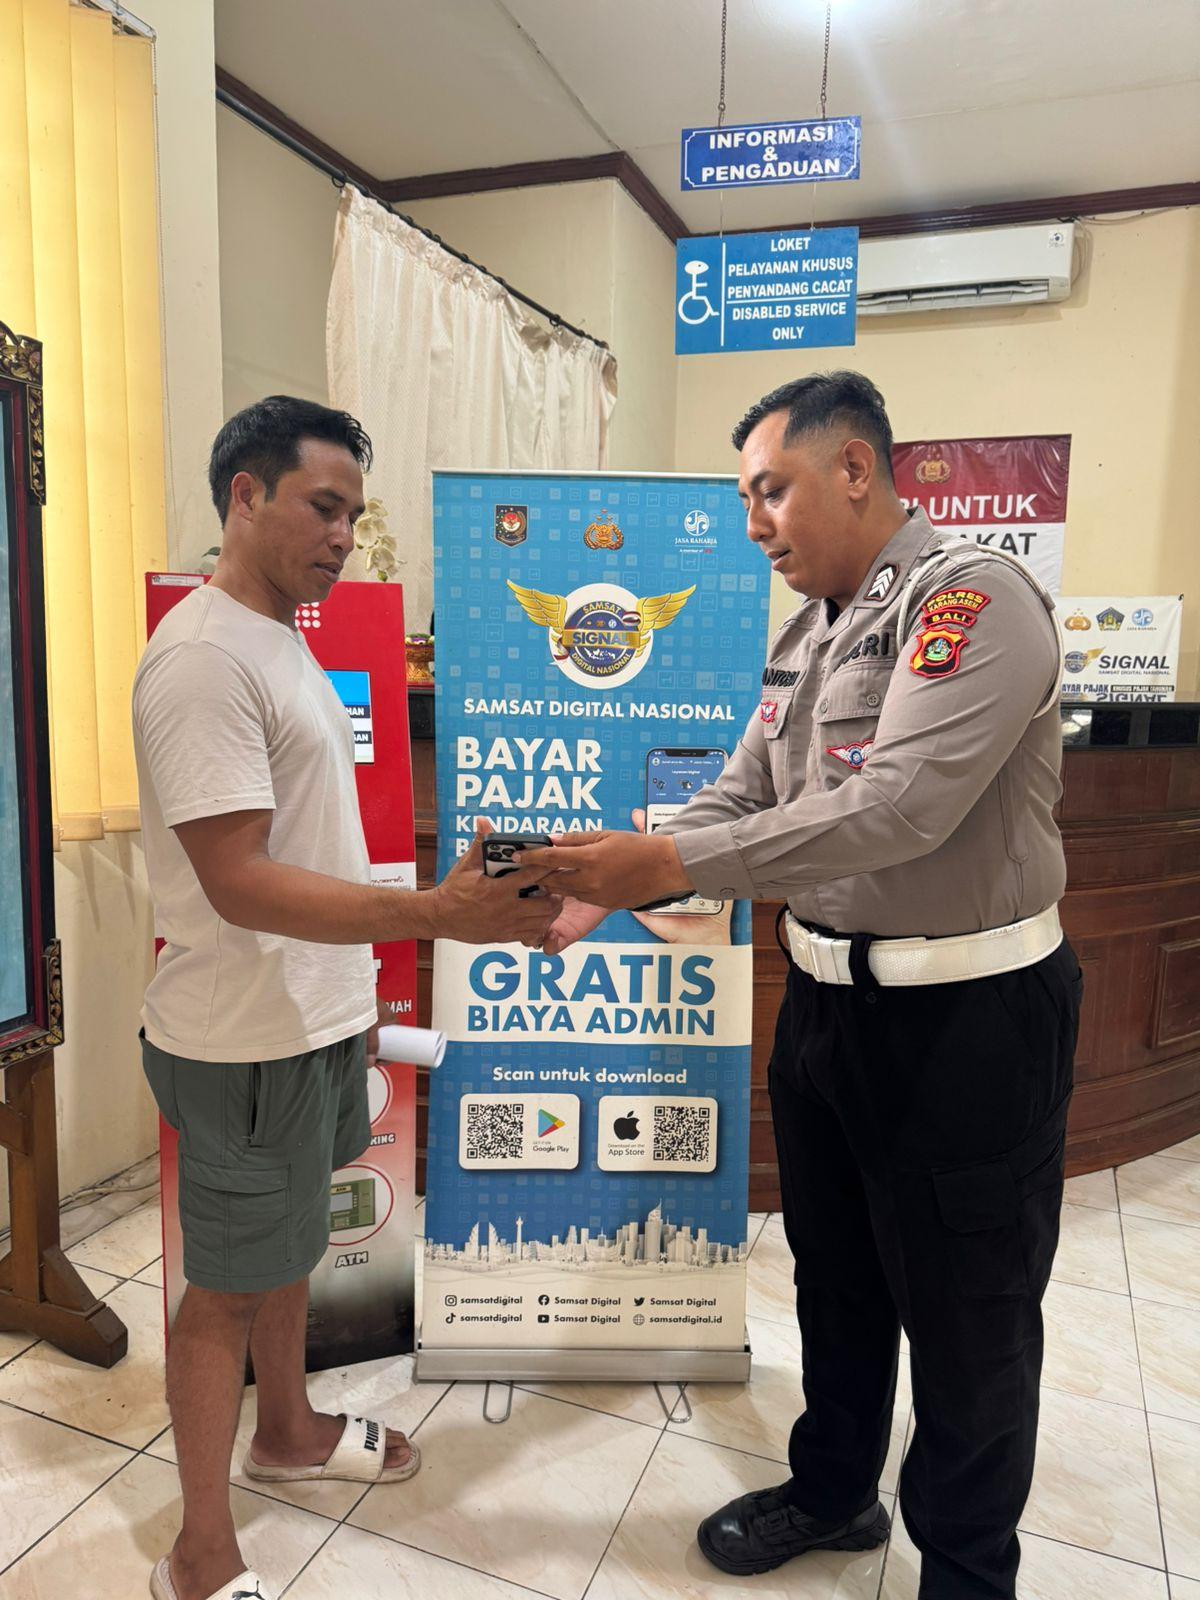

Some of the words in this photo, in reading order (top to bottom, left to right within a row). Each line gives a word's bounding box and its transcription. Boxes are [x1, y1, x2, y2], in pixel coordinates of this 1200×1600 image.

[709, 126, 833, 149] INFORMASI
[763, 146, 778, 161] &
[701, 159, 840, 182] PENGADUAN
[771, 237, 811, 252] LOKET
[728, 261, 799, 277] PELAYANAN
[802, 257, 853, 272] KHUSUS
[727, 281, 809, 299] PENYANDANG
[812, 279, 853, 294] CACAT
[732, 304, 791, 320] DISABLED
[794, 302, 847, 316] SERVICE
[772, 326, 804, 340] ONLY
[929, 493, 1038, 520] UNTUK
[927, 591, 984, 607] POLRES
[582, 602, 622, 615] SAMSAT
[932, 613, 967, 622] BALI
[572, 631, 630, 646] SIGNAL
[571, 652, 596, 673] DIGITAL
[596, 652, 632, 674] NASIONAL
[1098, 655, 1170, 669] SIGNAL
[1061, 683, 1082, 693] AYAR
[1083, 684, 1109, 693] PAJAK
[464, 698, 544, 715] SAMSAT
[549, 701, 624, 718] DIGITAL
[630, 703, 735, 721] NASIONAL
[457, 736, 603, 773] BAYAR
[456, 774, 602, 811] PAJAK
[469, 950, 716, 1006] GRATIS
[467, 1005, 576, 1032] BIAYA
[585, 1007, 715, 1036] ADMIN
[493, 1067, 534, 1082] Scan
[540, 1067, 590, 1082] untuk
[595, 1068, 687, 1084] download
[370, 1133, 396, 1146] KING
[533, 1145, 555, 1153] Google
[557, 1145, 569, 1153] Play
[336, 1251, 369, 1268] ATM
[460, 1295, 523, 1307] samsatdigital
[554, 1296, 588, 1306] Samsat
[591, 1296, 621, 1308] Digital
[650, 1297, 684, 1307] Samsat
[686, 1297, 717, 1309] Digital
[460, 1313, 523, 1325] samsatdigital
[554, 1314, 588, 1324] Samsat
[591, 1314, 621, 1326] Digital
[649, 1315, 723, 1327] samsatdigital.id
